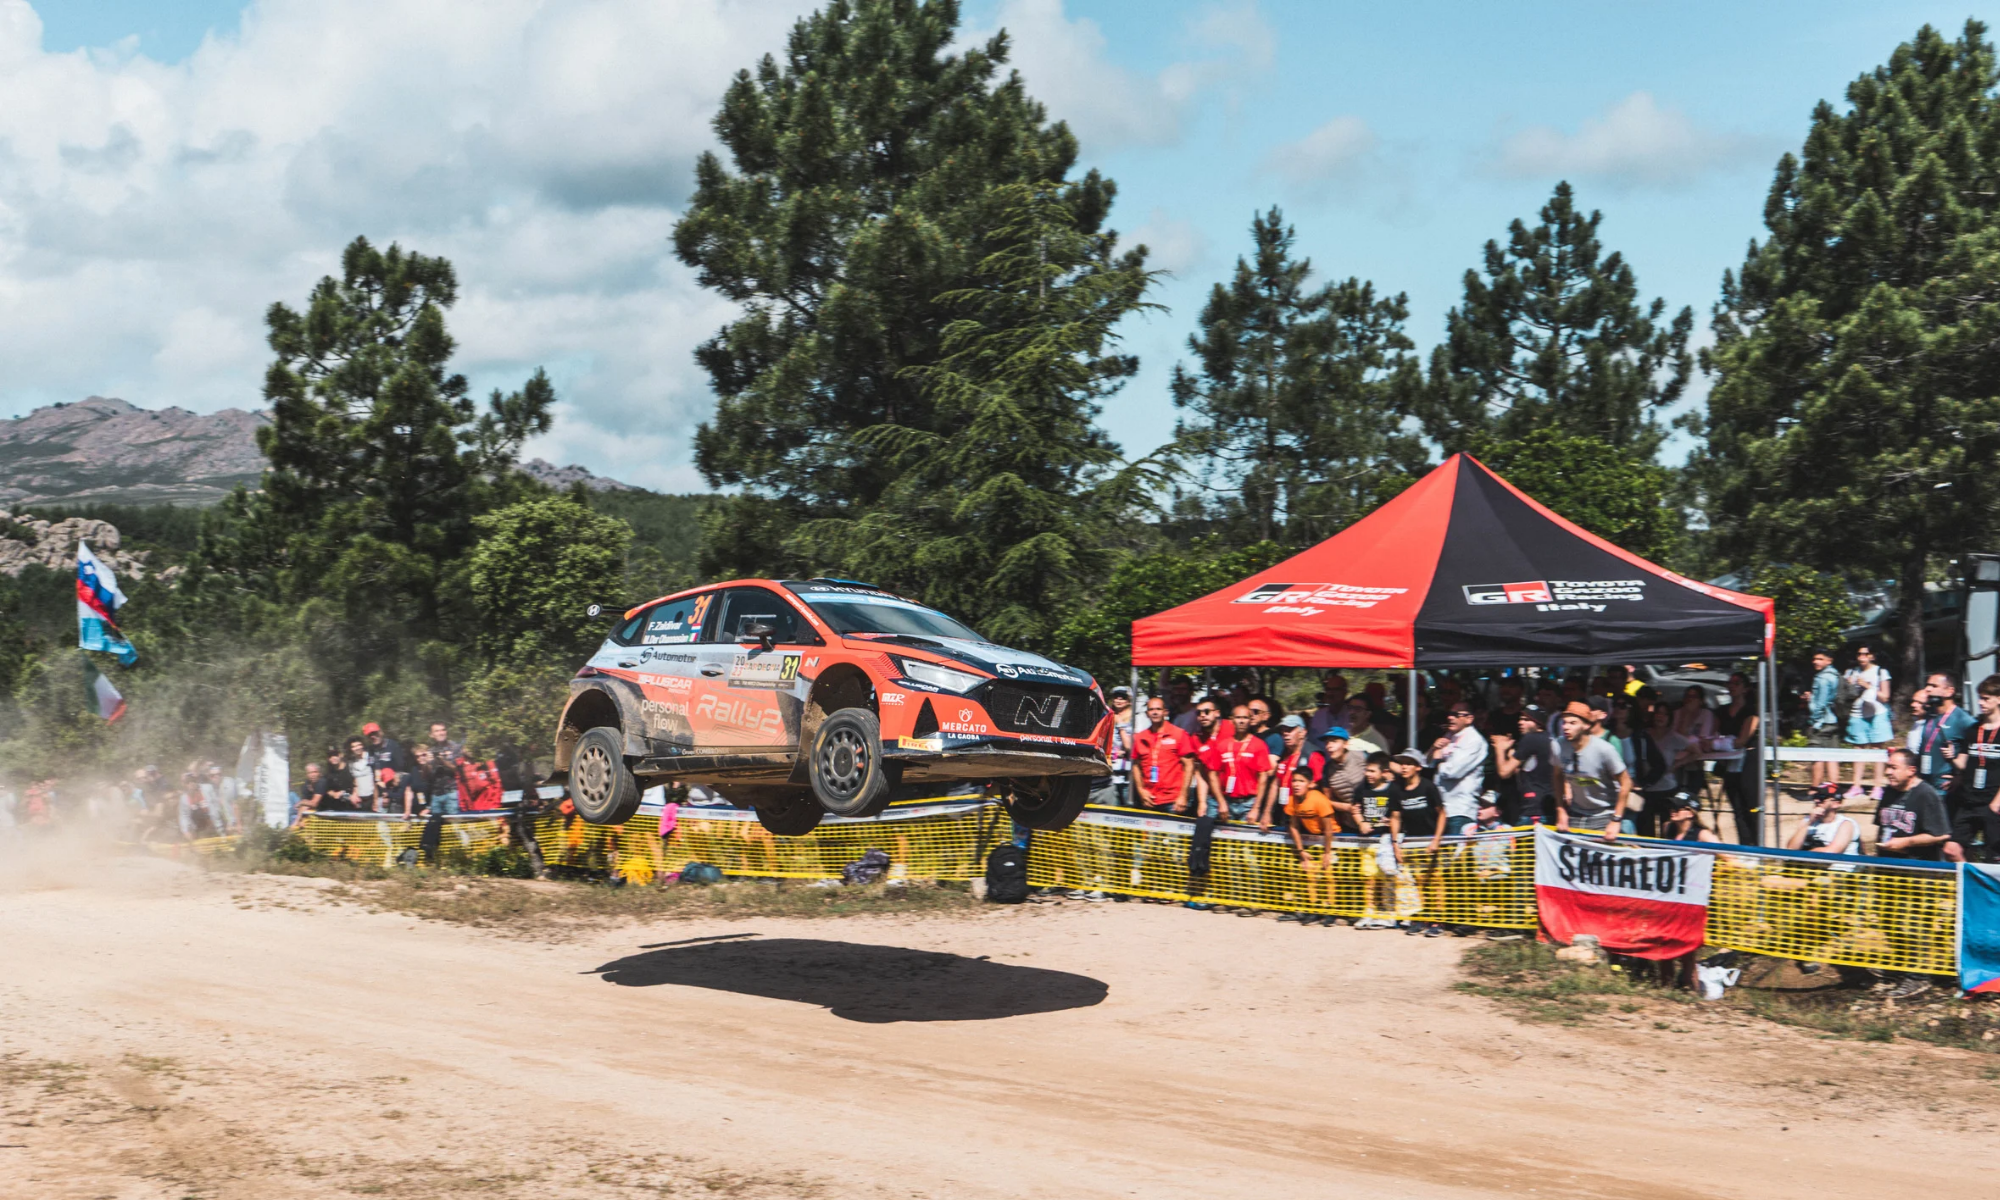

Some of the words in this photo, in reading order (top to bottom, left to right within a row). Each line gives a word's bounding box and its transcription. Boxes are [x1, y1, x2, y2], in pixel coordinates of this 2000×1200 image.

[1235, 591, 1312, 604] GR
[1302, 597, 1378, 609] Racing
[1468, 590, 1550, 604] GR
[1555, 593, 1645, 601] Racing
[687, 595, 713, 624] 31
[1262, 606, 1325, 616] Italy
[1536, 603, 1607, 612] Italy
[653, 651, 697, 663] Automotor
[735, 655, 746, 666] 20
[781, 656, 799, 679] 31
[641, 699, 690, 716] personal
[695, 694, 782, 734] Rally2
[653, 713, 679, 731] flow
[942, 721, 987, 733] MERCATO
